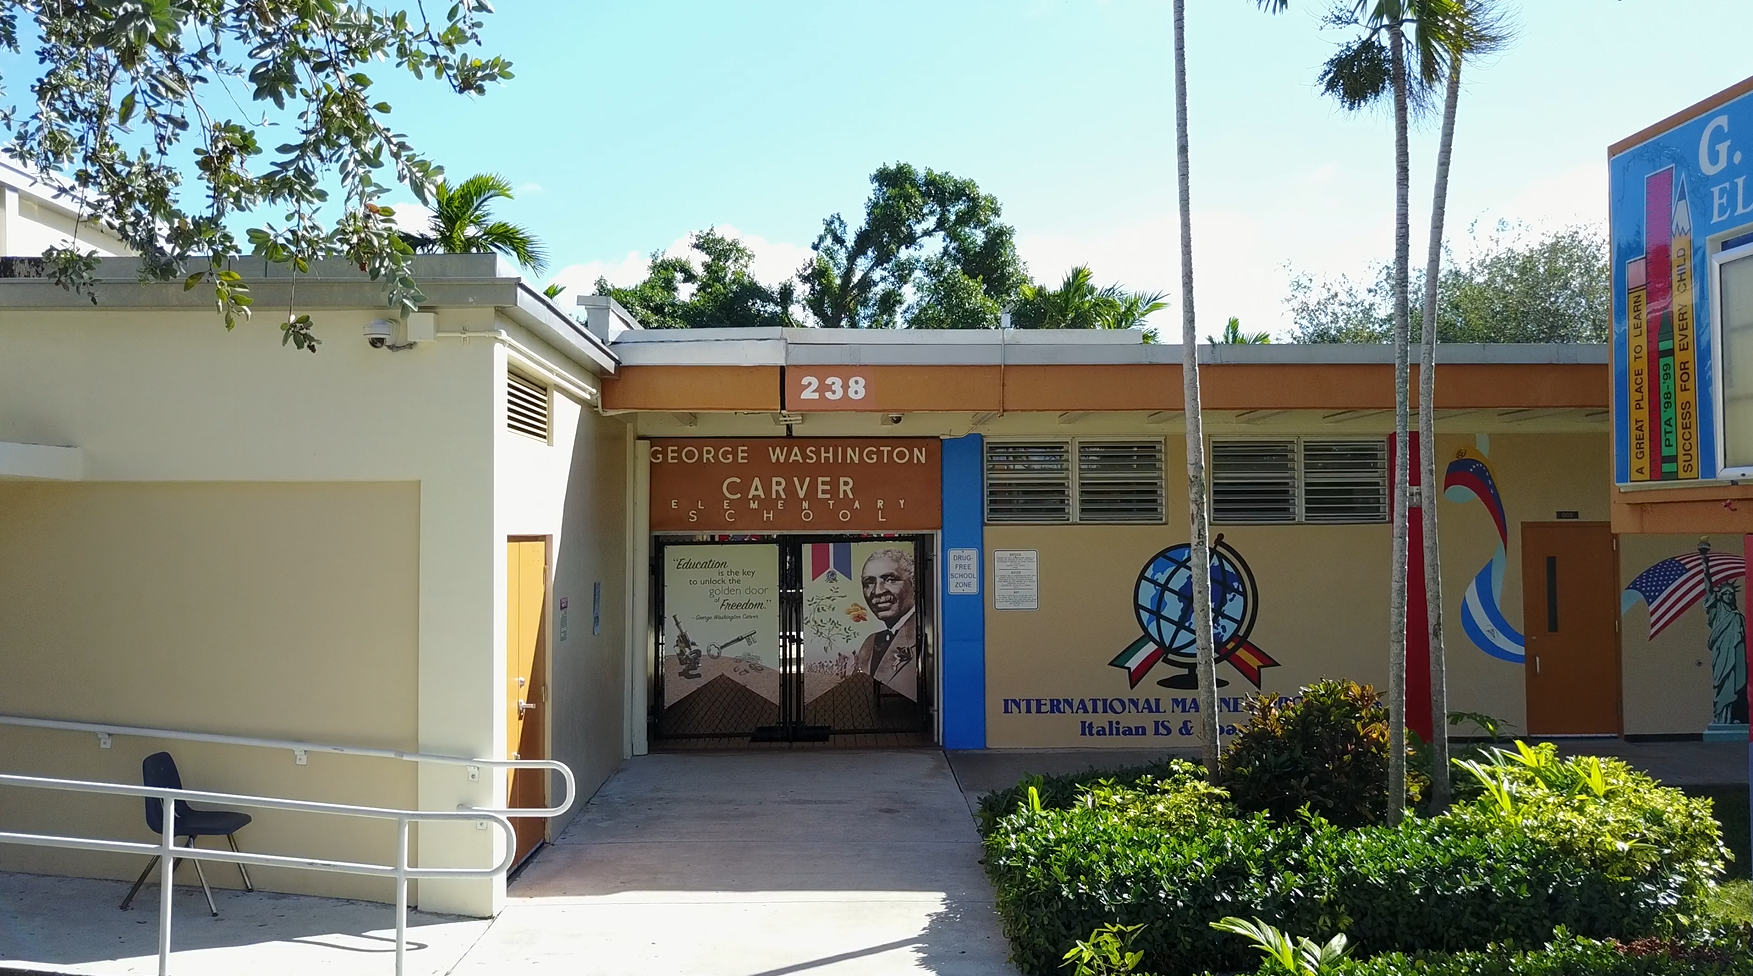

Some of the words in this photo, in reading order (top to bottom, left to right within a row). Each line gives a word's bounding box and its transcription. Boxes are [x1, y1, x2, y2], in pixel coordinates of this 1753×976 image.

[1699, 115, 1742, 176] G.
[1710, 175, 1753, 225] EL
[1676, 247, 1687, 293] CHILD
[1633, 294, 1643, 338] LEARN
[1678, 303, 1689, 352] EVERY
[1634, 344, 1643, 362] TO
[800, 376, 866, 400] 238
[1680, 361, 1691, 392] FOR
[1634, 368, 1644, 410] PLACE
[1635, 418, 1645, 460] GREAT
[1664, 417, 1674, 448] PTA
[1681, 401, 1693, 473] SUCCESS
[650, 446, 748, 464] GEORGE
[768, 446, 926, 464] WASHINGTON
[1635, 466, 1645, 475] A
[722, 476, 855, 500] CARVER
[671, 500, 905, 510] ELEMENTARY
[688, 510, 887, 522] SCHOOL
[700, 577, 726, 585] unlock
[728, 577, 741, 585] the
[718, 569, 725, 577] is
[726, 568, 740, 577] the
[742, 569, 756, 578] key
[709, 586, 741, 598] golden
[745, 586, 769, 595] door
[1003, 698, 1167, 714] INTERNATIONAL
[1080, 720, 1147, 736] Italian
[1153, 720, 1172, 736] IS
[1178, 719, 1194, 736] &
